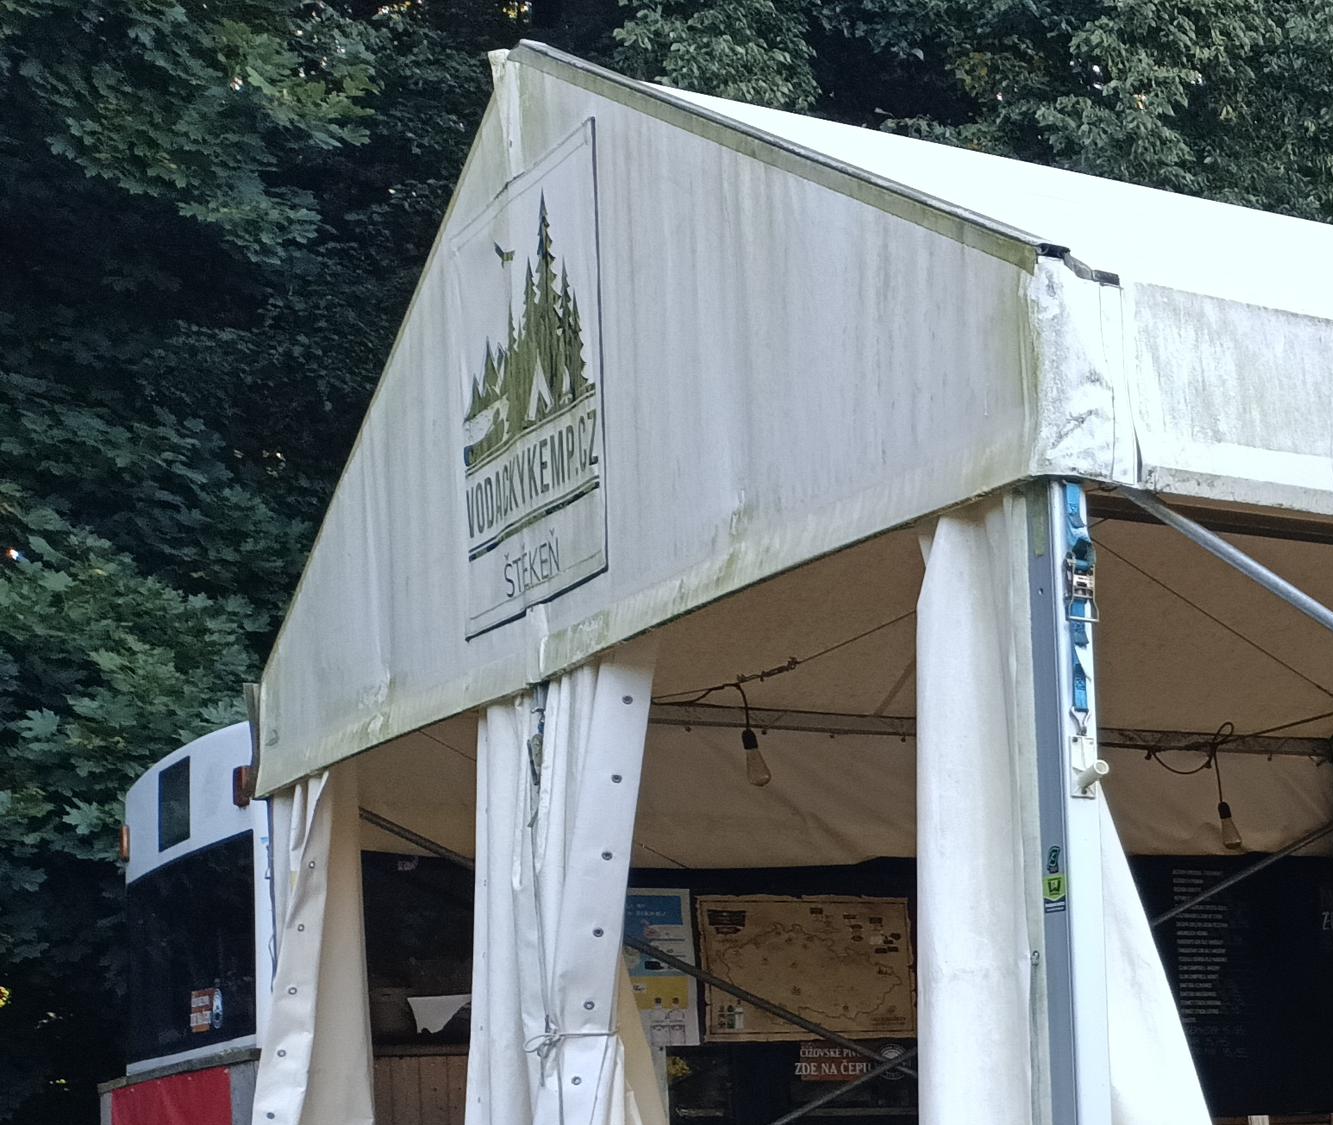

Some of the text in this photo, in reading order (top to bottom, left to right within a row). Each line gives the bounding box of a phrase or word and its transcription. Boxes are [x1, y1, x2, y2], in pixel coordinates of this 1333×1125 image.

[466, 409, 599, 539] VODACKYKEMP.CZ
[504, 528, 561, 599] ŠTĚKEŇ
[794, 1062, 818, 1075] ZDE
[821, 1063, 837, 1075] NA
